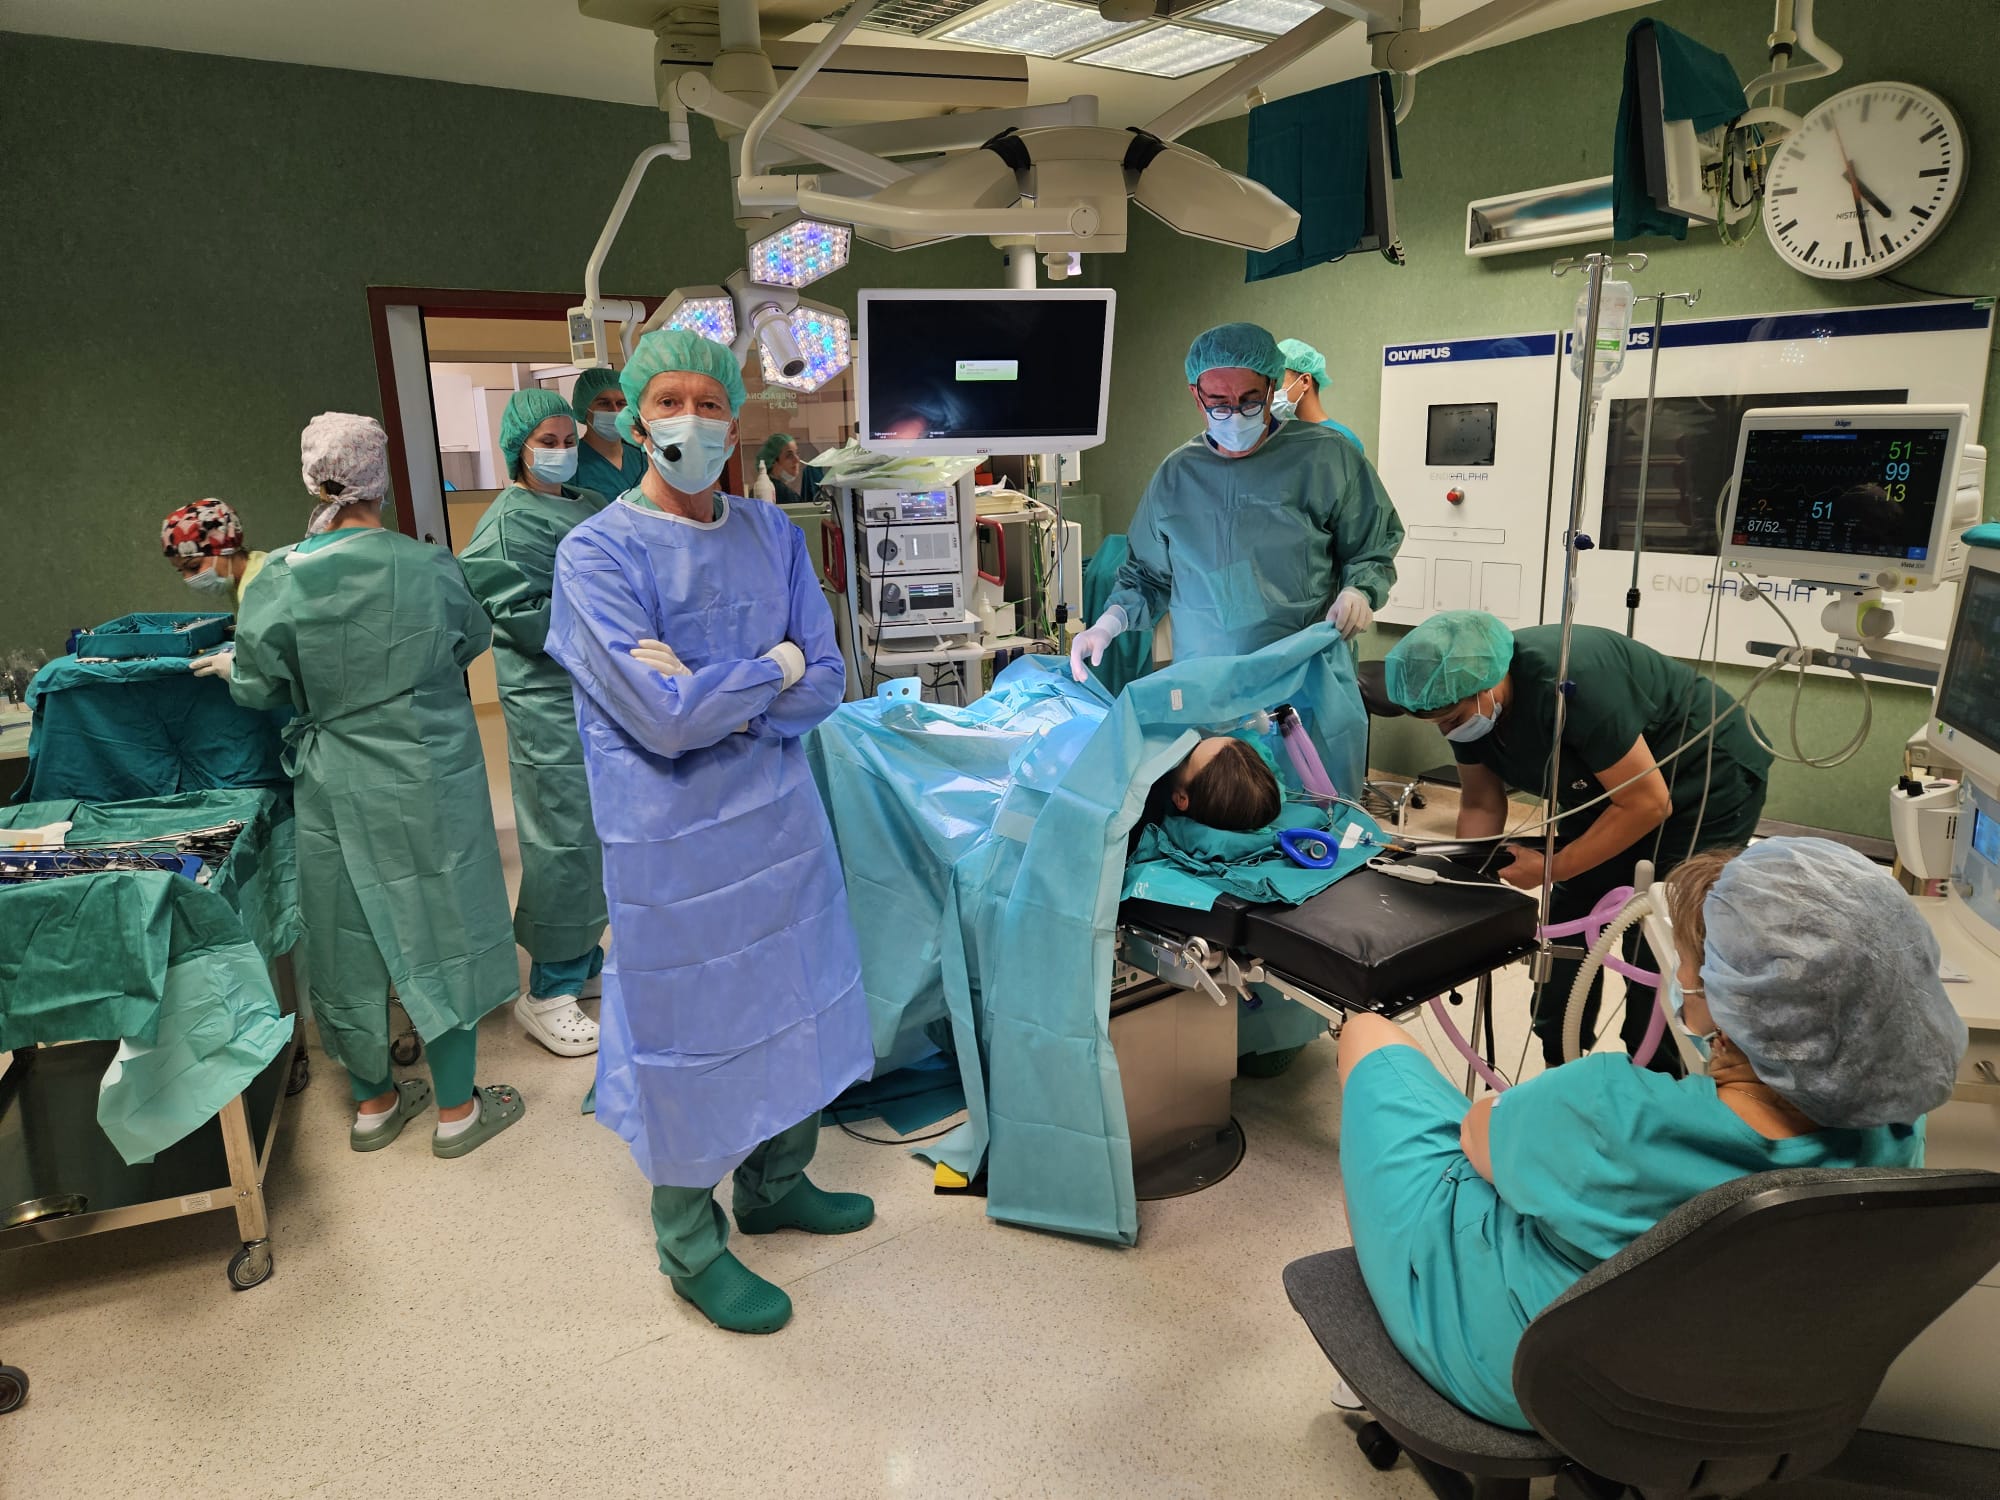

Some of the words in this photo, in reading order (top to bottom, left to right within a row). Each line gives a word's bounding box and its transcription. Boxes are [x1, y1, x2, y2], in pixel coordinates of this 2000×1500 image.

[1388, 346, 1450, 362] OLYMPUS
[1889, 441, 1912, 459] 51
[1885, 462, 1910, 481] 99
[1884, 483, 1906, 502] 13
[1811, 501, 1833, 519] 51
[1747, 520, 1780, 533] 87/52
[1651, 574, 1811, 603] ENDOAPHA
